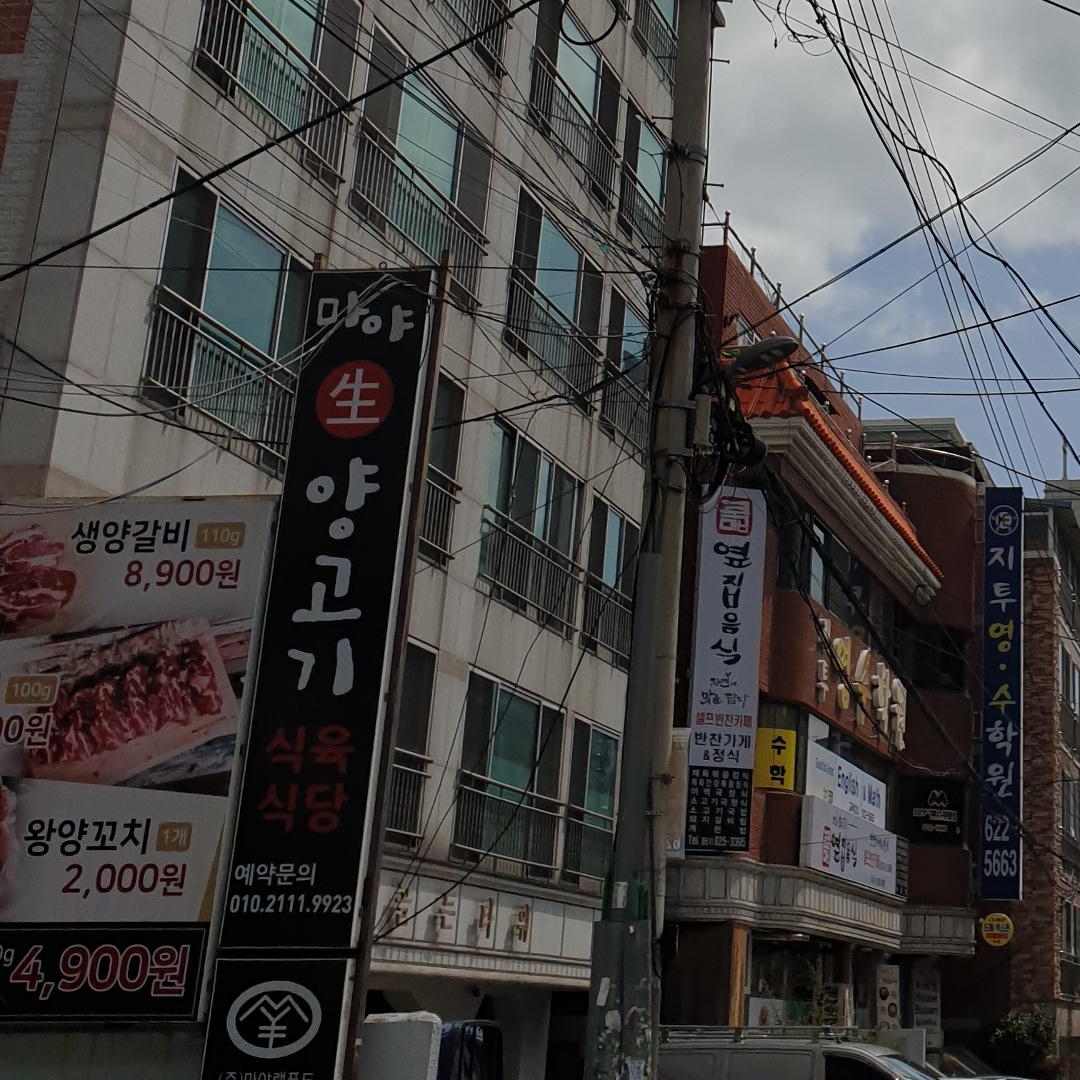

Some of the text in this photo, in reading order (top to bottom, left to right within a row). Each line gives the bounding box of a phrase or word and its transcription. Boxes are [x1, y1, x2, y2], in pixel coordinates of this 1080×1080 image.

[317, 290, 415, 343] 마야
[326, 368, 381, 426] 生
[71, 519, 241, 555] 생양갈비 110g
[123, 558, 241, 593] 8,900원
[287, 456, 381, 697] 양고기
[11, 680, 52, 702] 100g
[0, 714, 53, 750] 0원
[694, 730, 752, 750] 반찬가게
[264, 725, 356, 777] 식육
[769, 735, 787, 786] 수학
[256, 783, 350, 834] 식당
[23, 817, 152, 857] 왕양꼬치
[984, 814, 1011, 842] 622
[61, 862, 188, 899] 2,000원
[233, 862, 317, 888] 예약문의
[983, 849, 1018, 877] 5663
[229, 894, 353, 915] 010.2111.9923
[9, 942, 191, 1001] 4,900원
